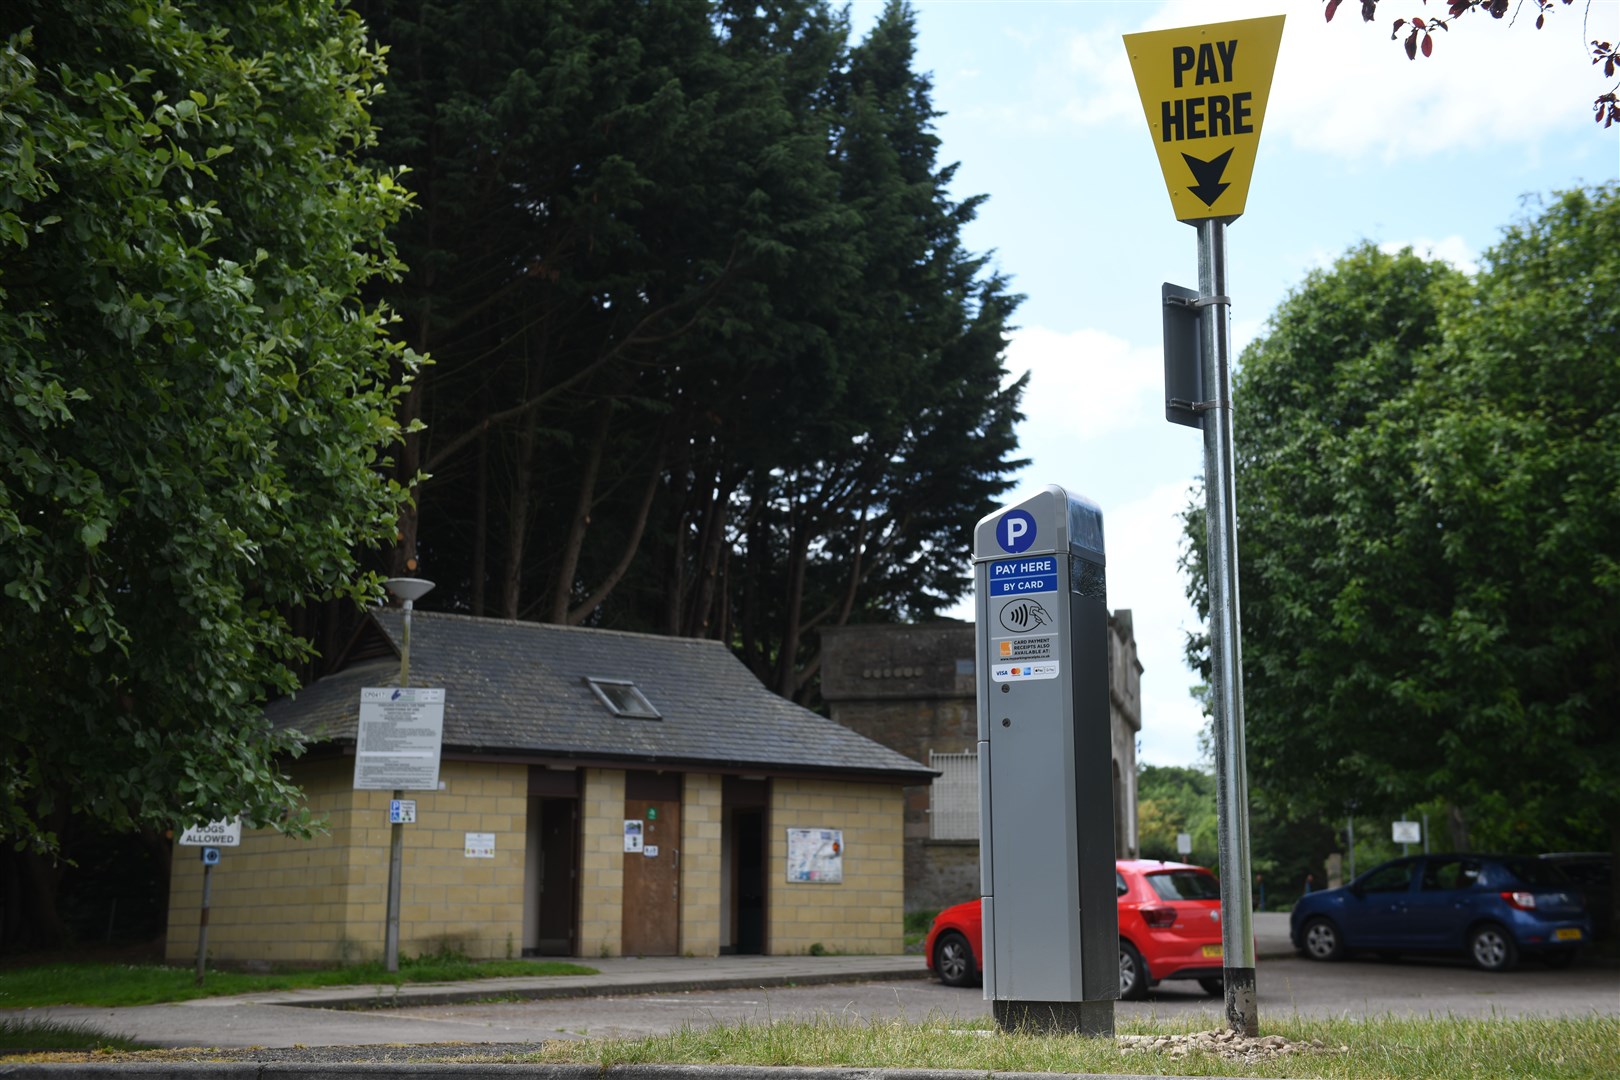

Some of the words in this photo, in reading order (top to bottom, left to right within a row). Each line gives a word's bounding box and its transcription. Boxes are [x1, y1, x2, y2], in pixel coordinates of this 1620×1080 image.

[1172, 39, 1238, 88] PAY
[1161, 91, 1254, 142] HERE
[1007, 517, 1028, 547] P
[995, 564, 1017, 575] PAY
[1020, 560, 1051, 573] HERE
[1003, 583, 1016, 591] BY
[1017, 580, 1044, 590] CARD
[196, 825, 225, 833] DOGS
[186, 834, 234, 843] ALLOWED
